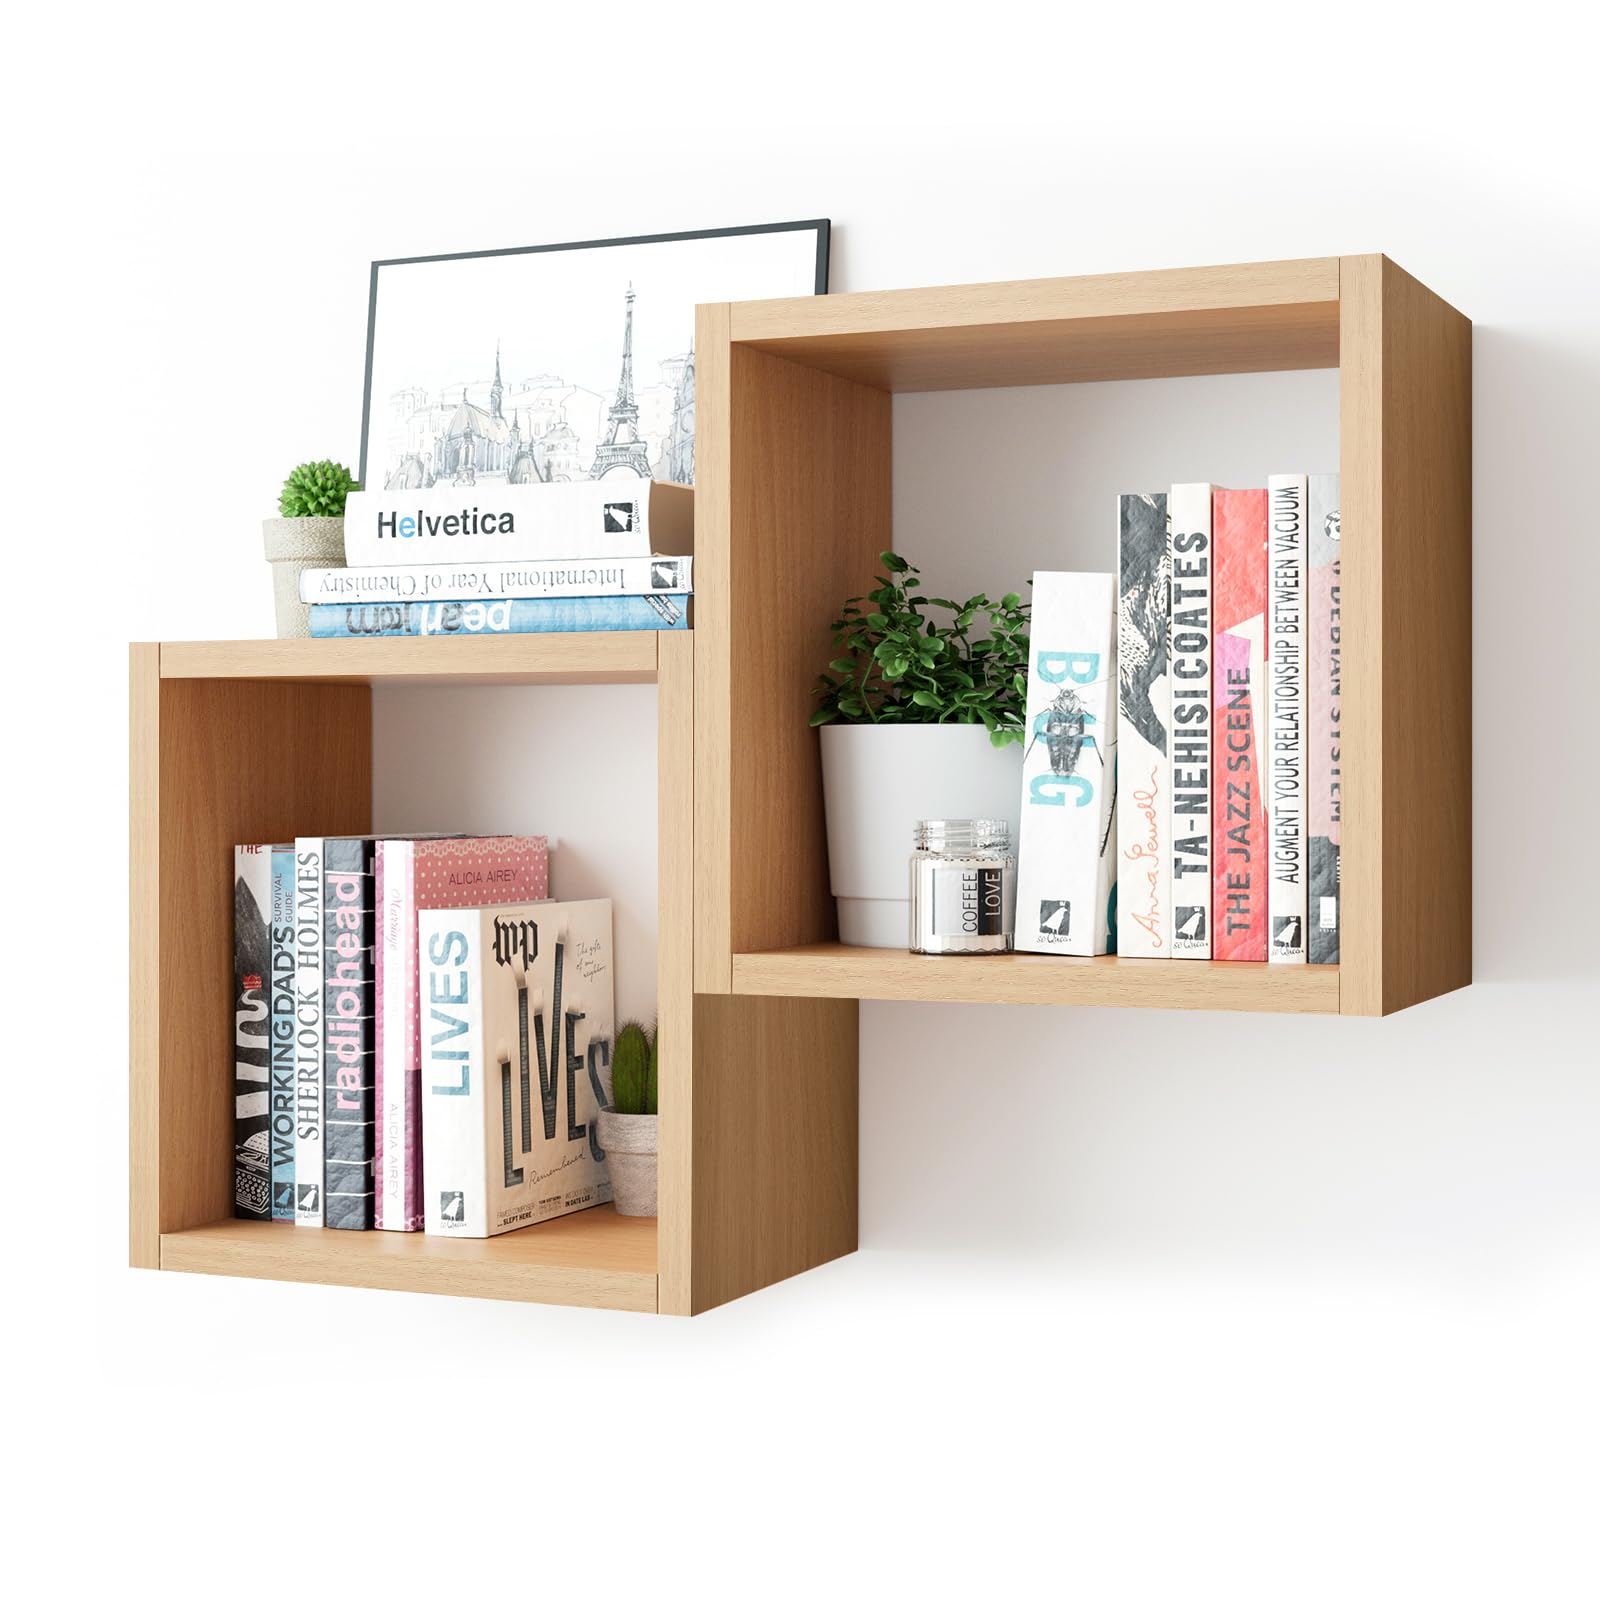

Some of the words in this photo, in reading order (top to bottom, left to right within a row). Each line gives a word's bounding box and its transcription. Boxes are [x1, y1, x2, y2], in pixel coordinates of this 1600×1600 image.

[378, 507, 515, 538] Helvetica
[1275, 486, 1299, 553] VACUUM
[320, 572, 417, 597] Chemistry
[421, 574, 442, 596] of
[449, 572, 493, 593] Year
[501, 568, 625, 593] International
[1173, 532, 1208, 680] COATES
[1275, 559, 1299, 633] BETWEEN
[420, 600, 513, 636] pearl
[1227, 668, 1250, 771] SCENE
[1275, 640, 1299, 752] RELATIONSHIP
[1173, 690, 1208, 879] TA-NEHISI
[1275, 757, 1299, 800] YOUR
[1227, 782, 1250, 863] JAZZ
[1275, 806, 1299, 883] AUGMENT
[274, 873, 283, 922] SURVIVAL
[286, 892, 294, 923] GUIDE
[297, 852, 319, 969] HOLMES
[449, 871, 482, 885] ALICIA
[487, 869, 518, 883] AIREY
[962, 873, 978, 932] COFFEE
[985, 872, 1001, 916] LOVE
[1131, 870, 1162, 948] Anna
[1227, 873, 1250, 936] THE
[273, 926, 295, 1015] DAD'S
[327, 875, 361, 1110] radiohead
[428, 930, 471, 1096] LIVES
[273, 1020, 294, 1168] WORKING
[297, 986, 319, 1141] SHERLOCK
[501, 942, 610, 1188] LIVES
[389, 1103, 399, 1149] ALICIA
[389, 1155, 399, 1198] AIREY
